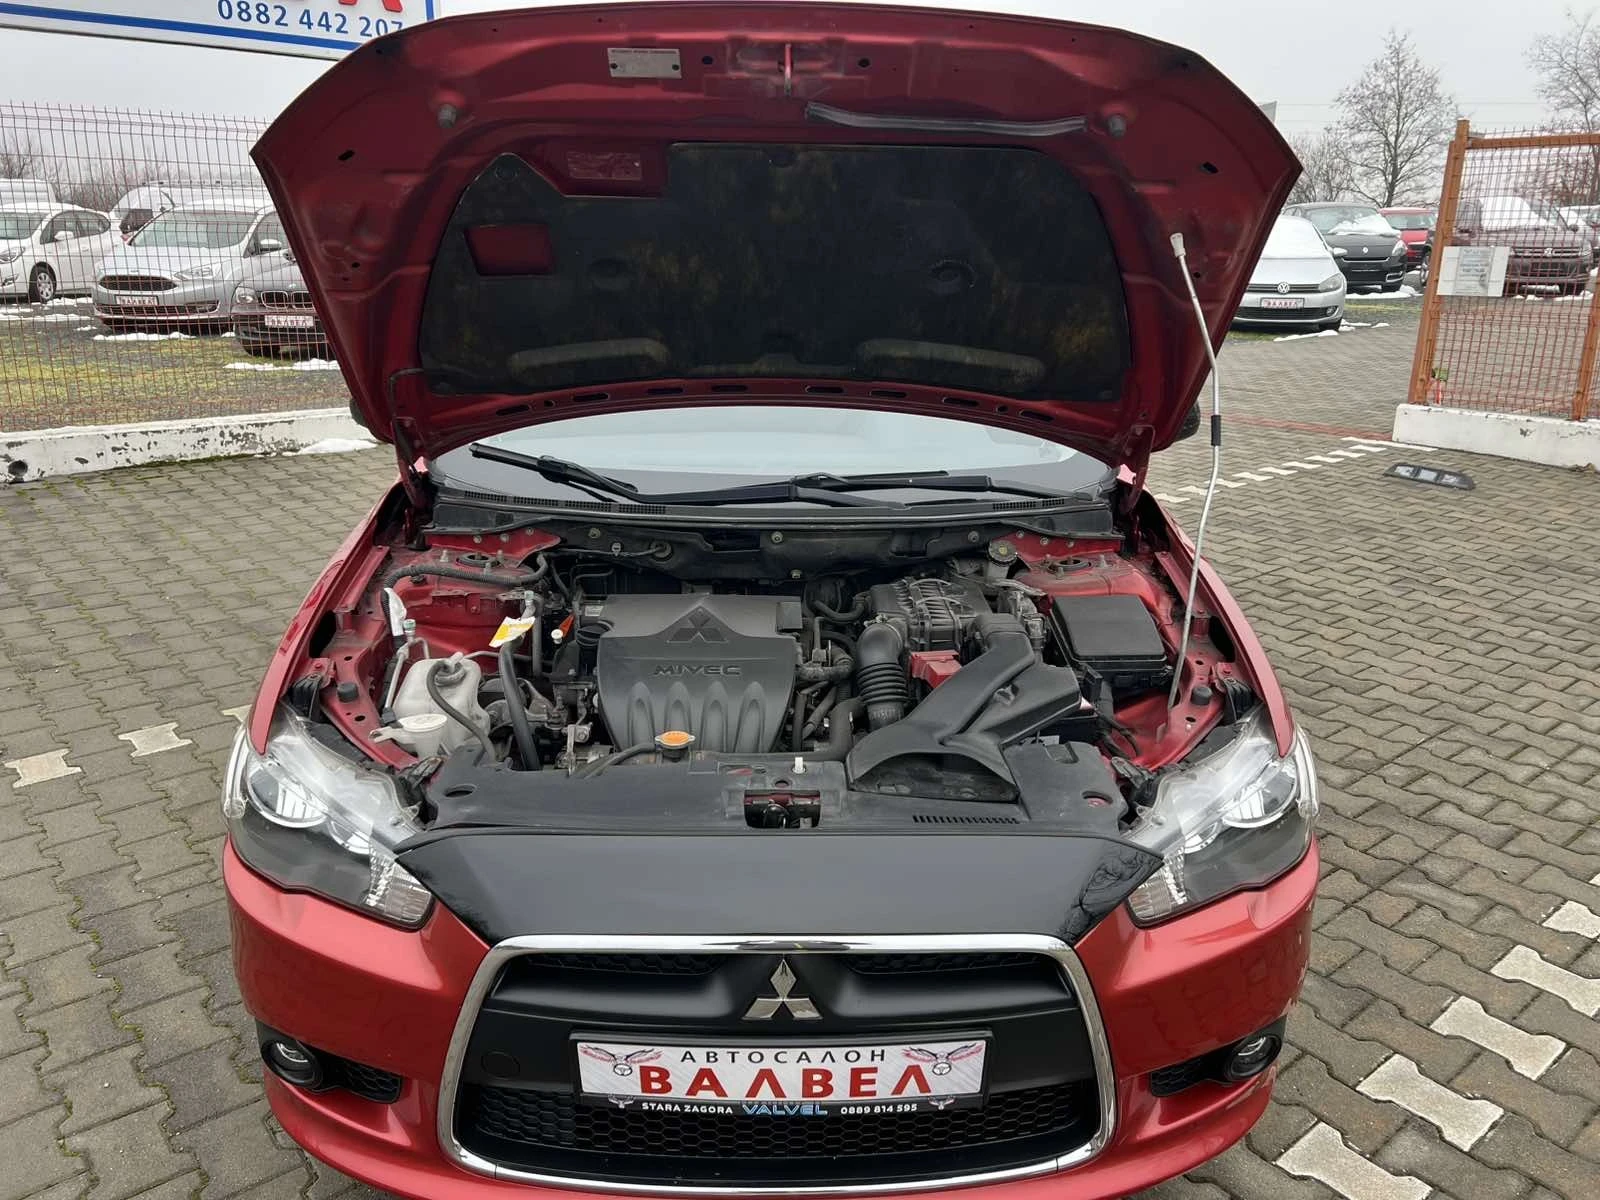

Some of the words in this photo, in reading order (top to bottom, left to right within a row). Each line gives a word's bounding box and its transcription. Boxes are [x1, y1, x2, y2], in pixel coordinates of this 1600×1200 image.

[218, 0, 288, 27] 0882
[299, 9, 349, 34] 442
[653, 664, 741, 677] MIVEC
[680, 1050, 885, 1064] АВТОСАЛОН
[639, 1064, 932, 1099] ВАЛВЕЛ
[642, 1102, 680, 1112] STARA
[684, 1104, 733, 1114] ZAGORA
[742, 1104, 828, 1116] VALVEL
[841, 1105, 870, 1114] 0889
[874, 1104, 894, 1113] 814
[897, 1103, 918, 1112] 595
